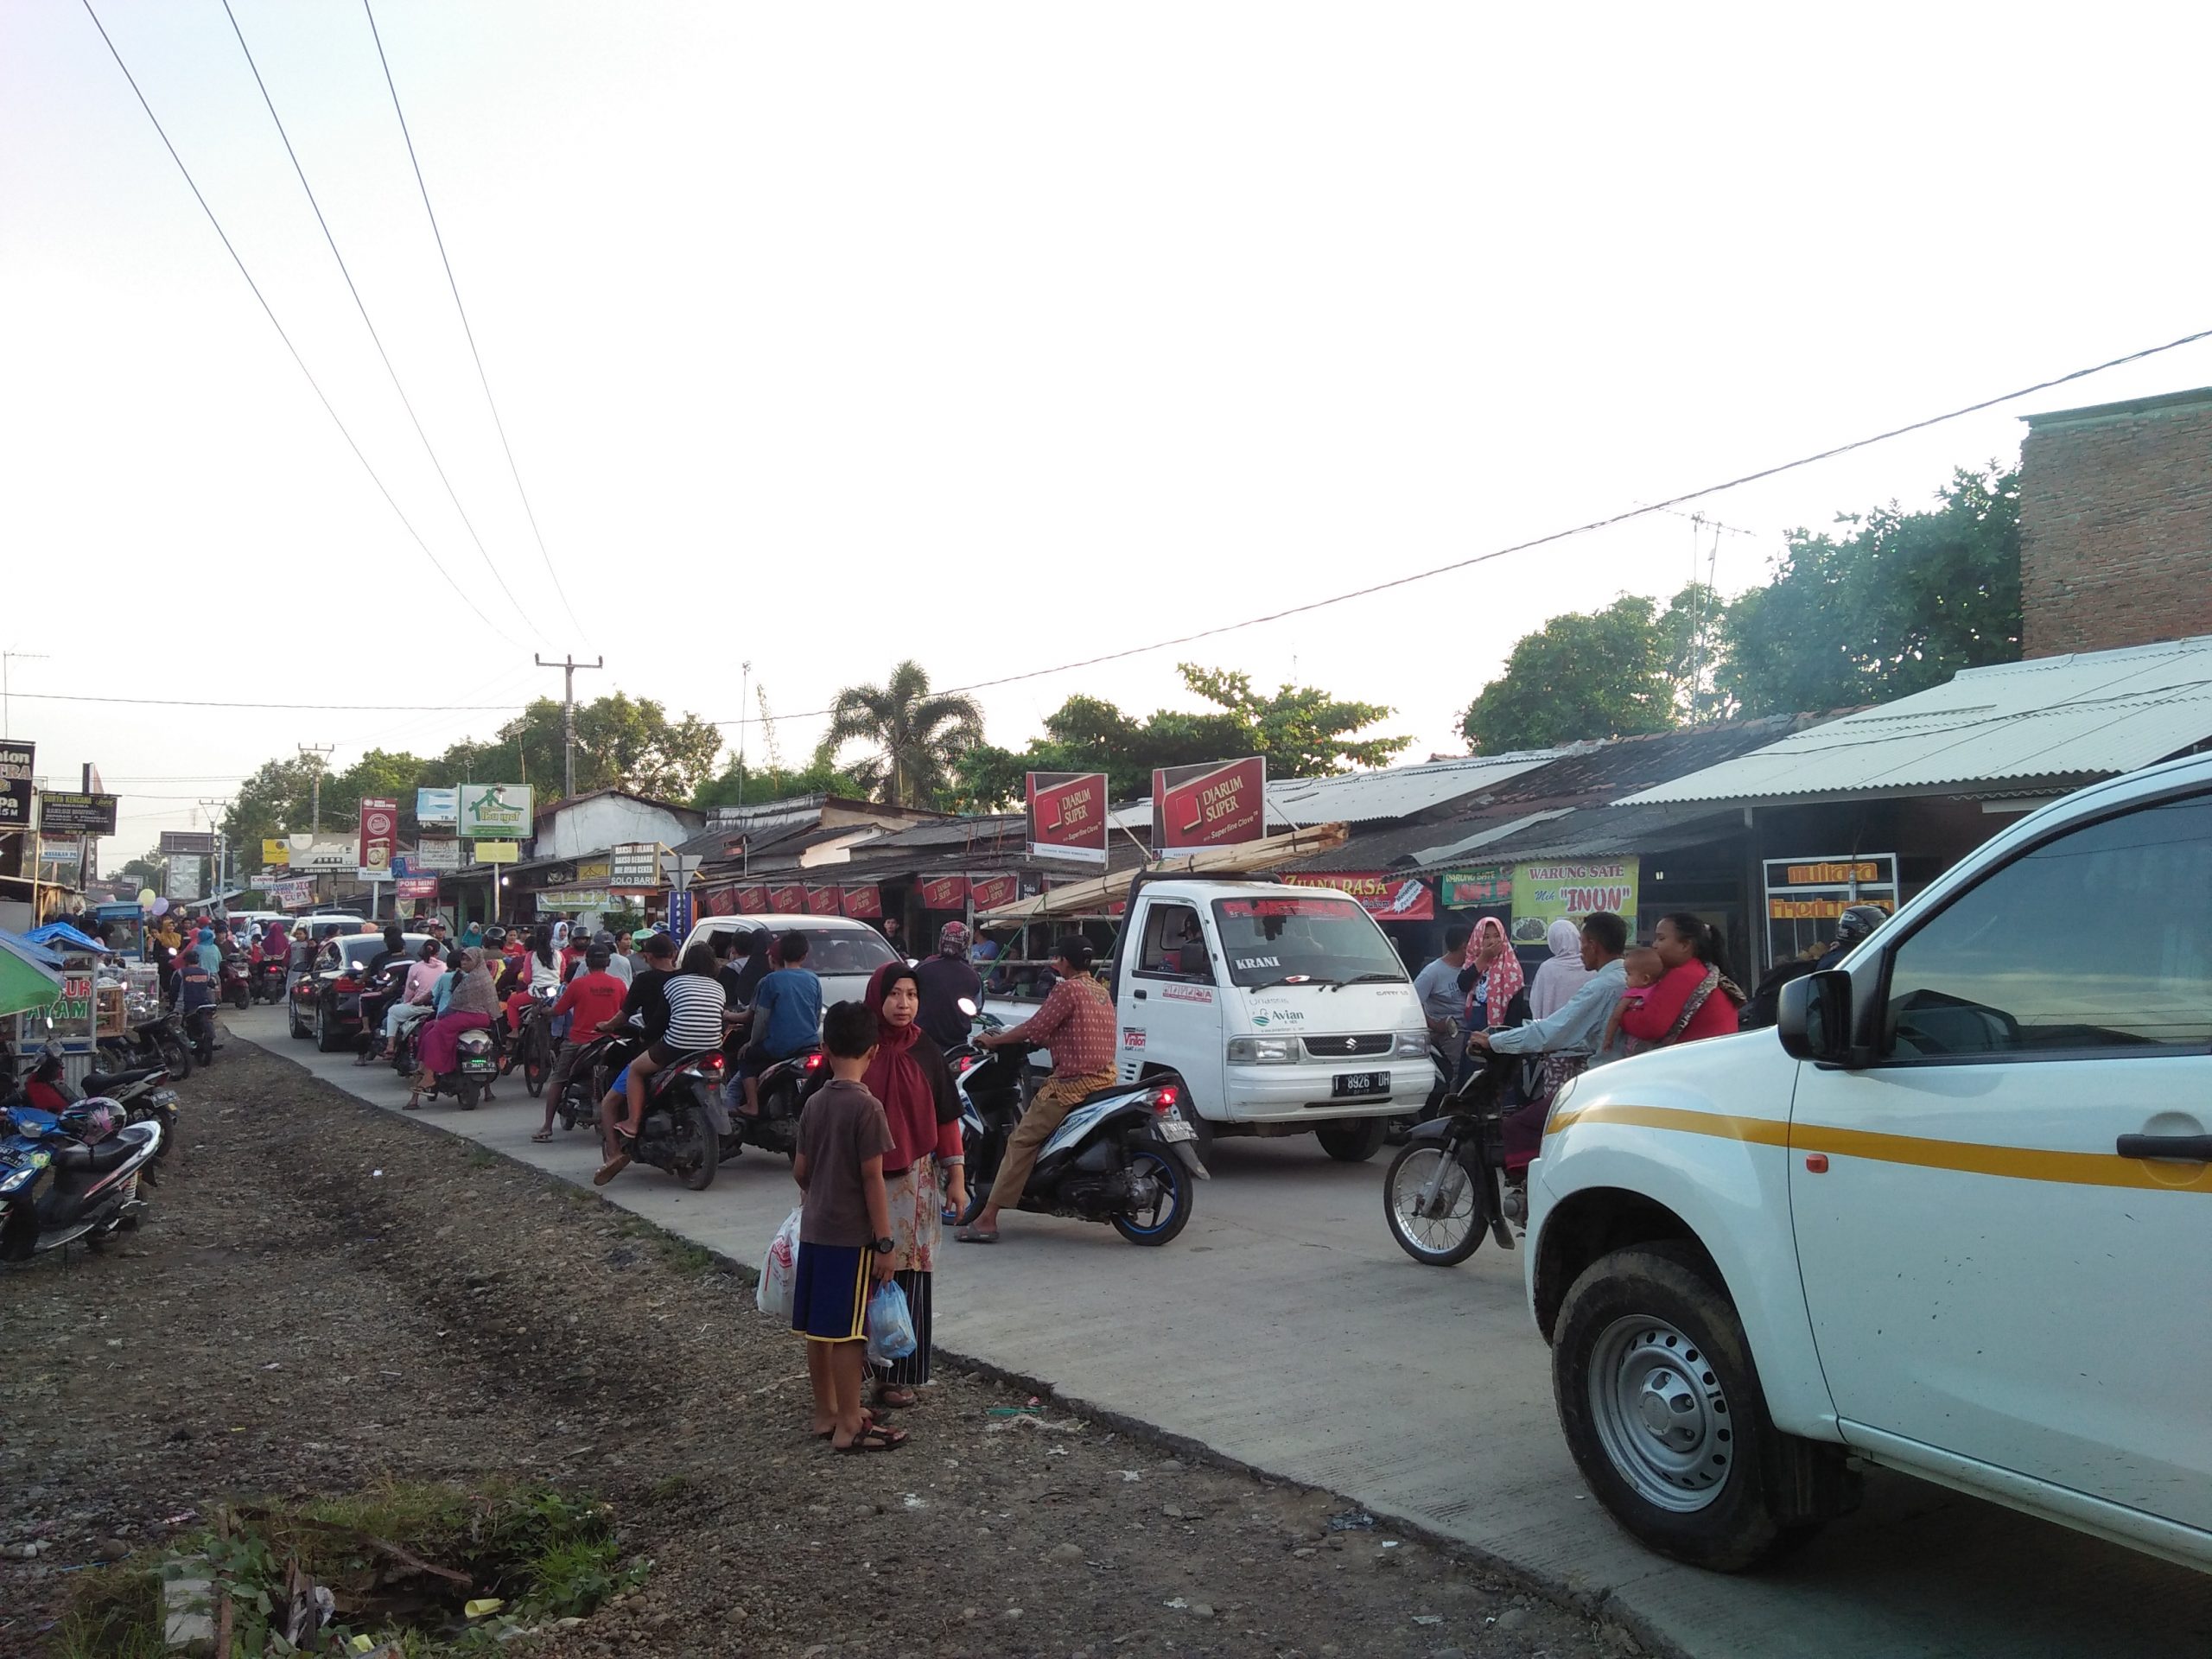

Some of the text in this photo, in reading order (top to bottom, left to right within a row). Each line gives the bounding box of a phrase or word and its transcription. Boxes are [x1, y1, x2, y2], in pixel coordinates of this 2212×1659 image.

[1062, 788, 1091, 810] DJARUM
[1202, 775, 1243, 805] DJARUM
[1064, 804, 1088, 825] SUPER
[1205, 796, 1239, 823] SUPER
[1211, 822, 1237, 840] Superfine
[1446, 874, 1475, 883] WARUNG
[1529, 864, 1625, 880] WARUNG SATE
[1342, 879, 1388, 895] RASA
[1535, 890, 1555, 901] Mih
[1235, 956, 1281, 970] KRANI
[63, 979, 92, 997] UR
[26, 1001, 88, 1020] AYAM
[1272, 1009, 1305, 1020] Avian
[1334, 1071, 1389, 1091] T 8926 DH
